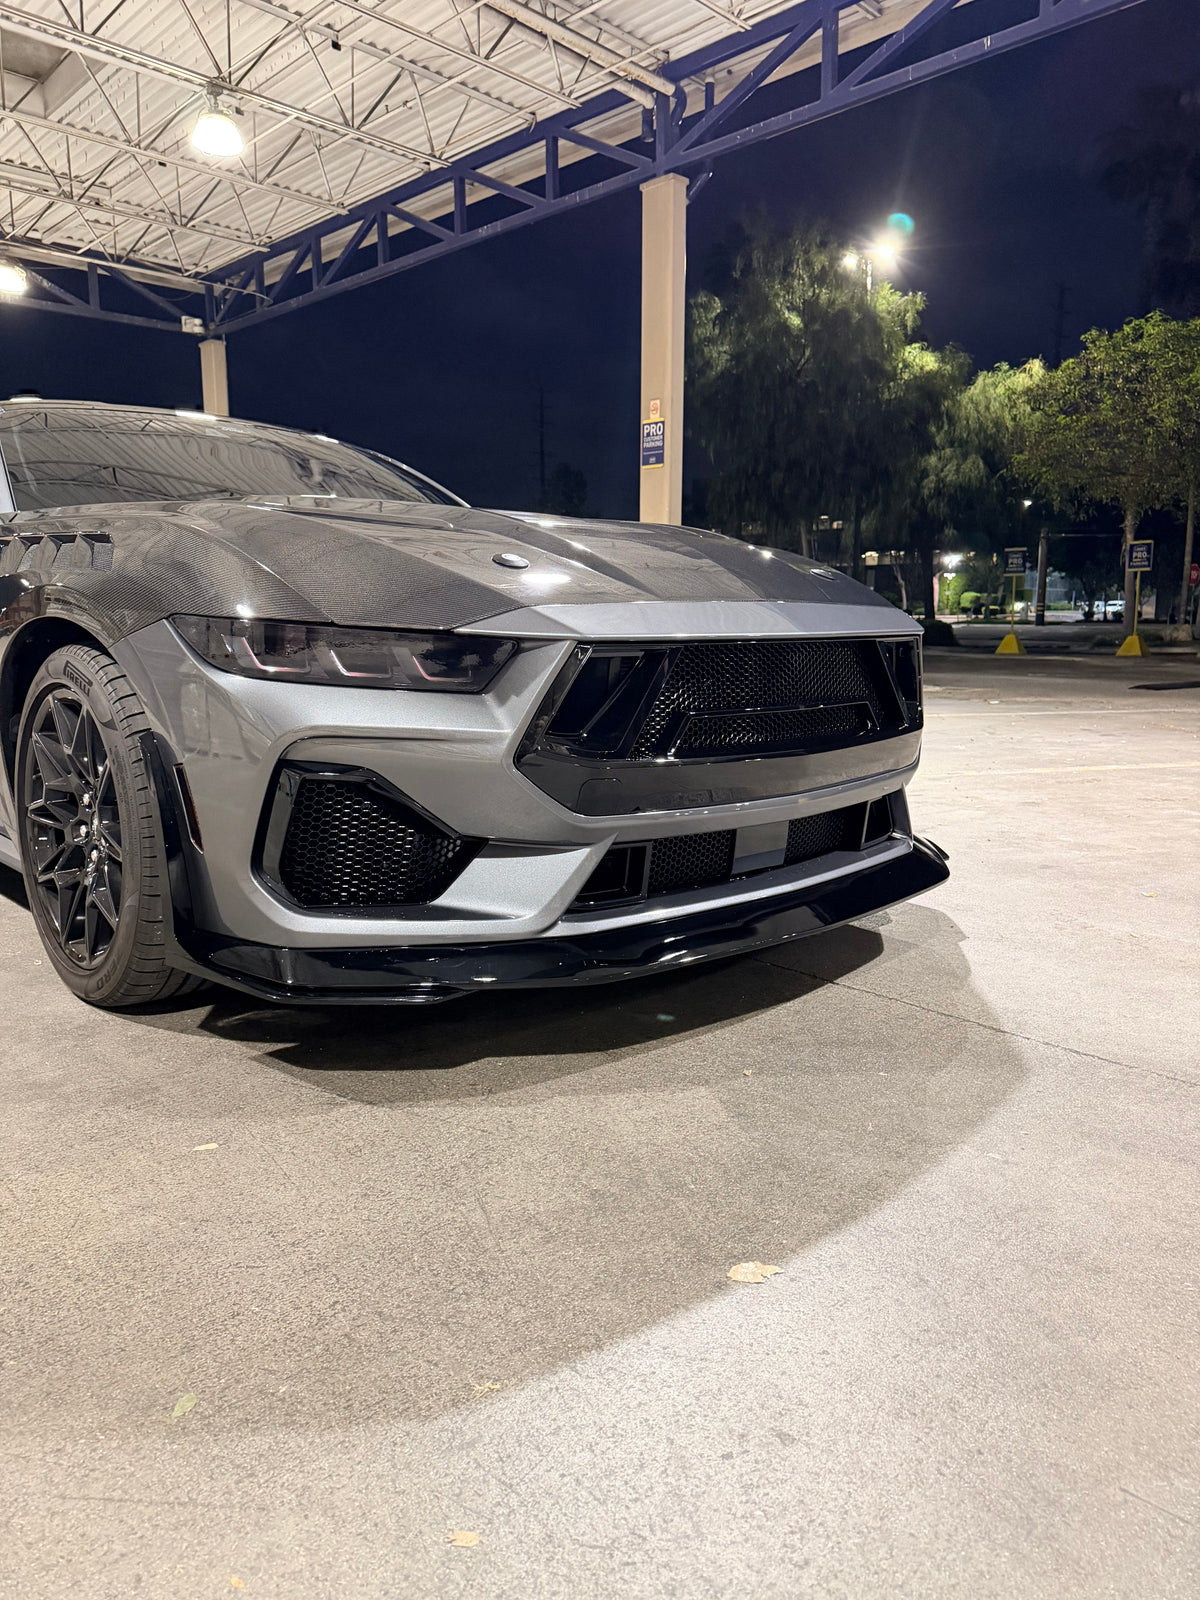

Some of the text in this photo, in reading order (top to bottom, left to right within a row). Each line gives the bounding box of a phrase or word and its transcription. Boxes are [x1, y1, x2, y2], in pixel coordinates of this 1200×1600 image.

[643, 423, 664, 437] PRO
[643, 440, 664, 448] PARKING
[1132, 551, 1148, 559] PRO
[63, 660, 93, 697] PIRELLI
